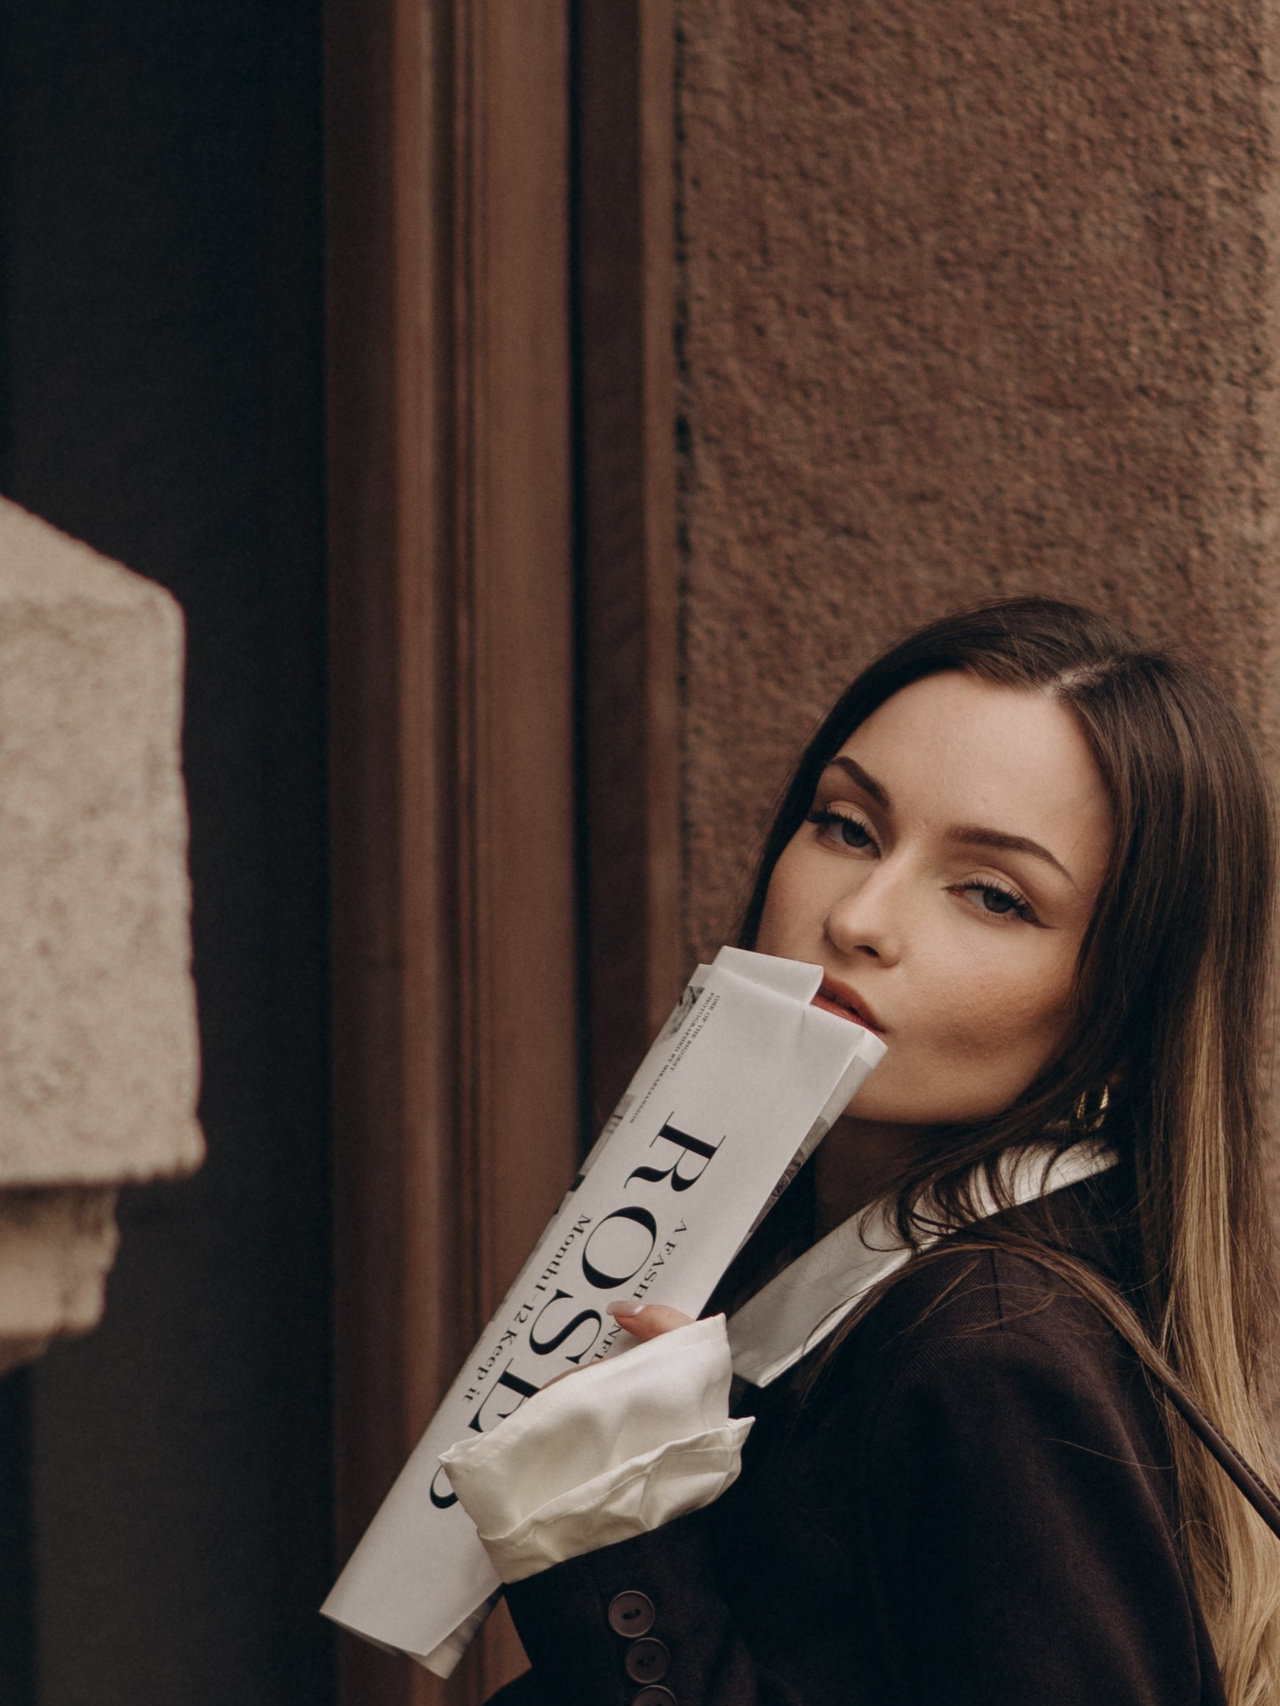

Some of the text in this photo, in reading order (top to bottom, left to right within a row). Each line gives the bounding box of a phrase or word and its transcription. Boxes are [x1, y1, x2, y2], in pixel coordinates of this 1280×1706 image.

[667, 993, 722, 1072] ONE OF THE BIGGEST
[672, 991, 716, 1054] PHOTOGRAPHED
[666, 1051, 677, 1064] BY
[672, 1217, 688, 1235] A
[475, 1327, 518, 1382] Keep
[462, 1385, 481, 1405] it
